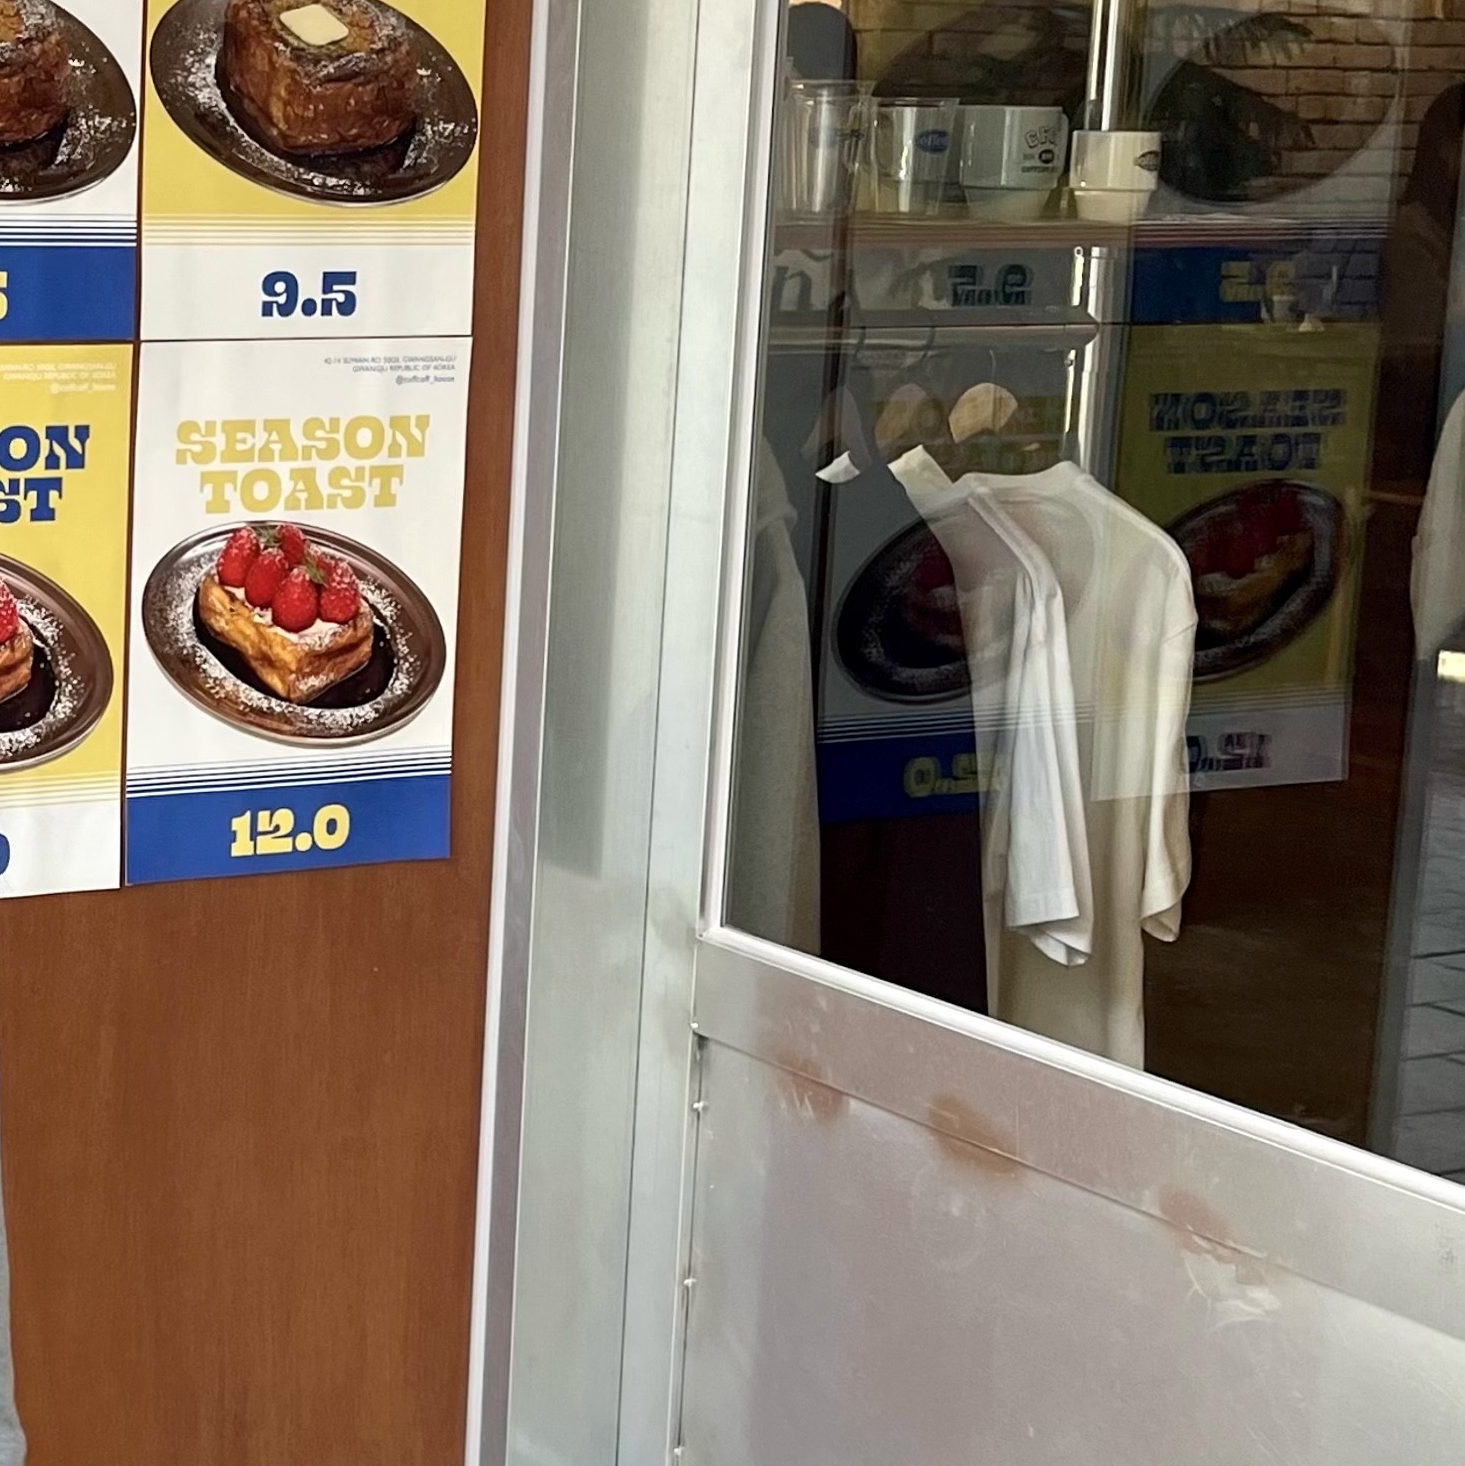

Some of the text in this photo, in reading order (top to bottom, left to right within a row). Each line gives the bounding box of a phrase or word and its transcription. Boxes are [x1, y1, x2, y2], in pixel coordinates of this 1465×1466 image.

[261, 271, 358, 318] 9.5
[175, 414, 431, 465] SEASON
[199, 464, 405, 514] TOAST
[230, 804, 351, 858] 12.0
